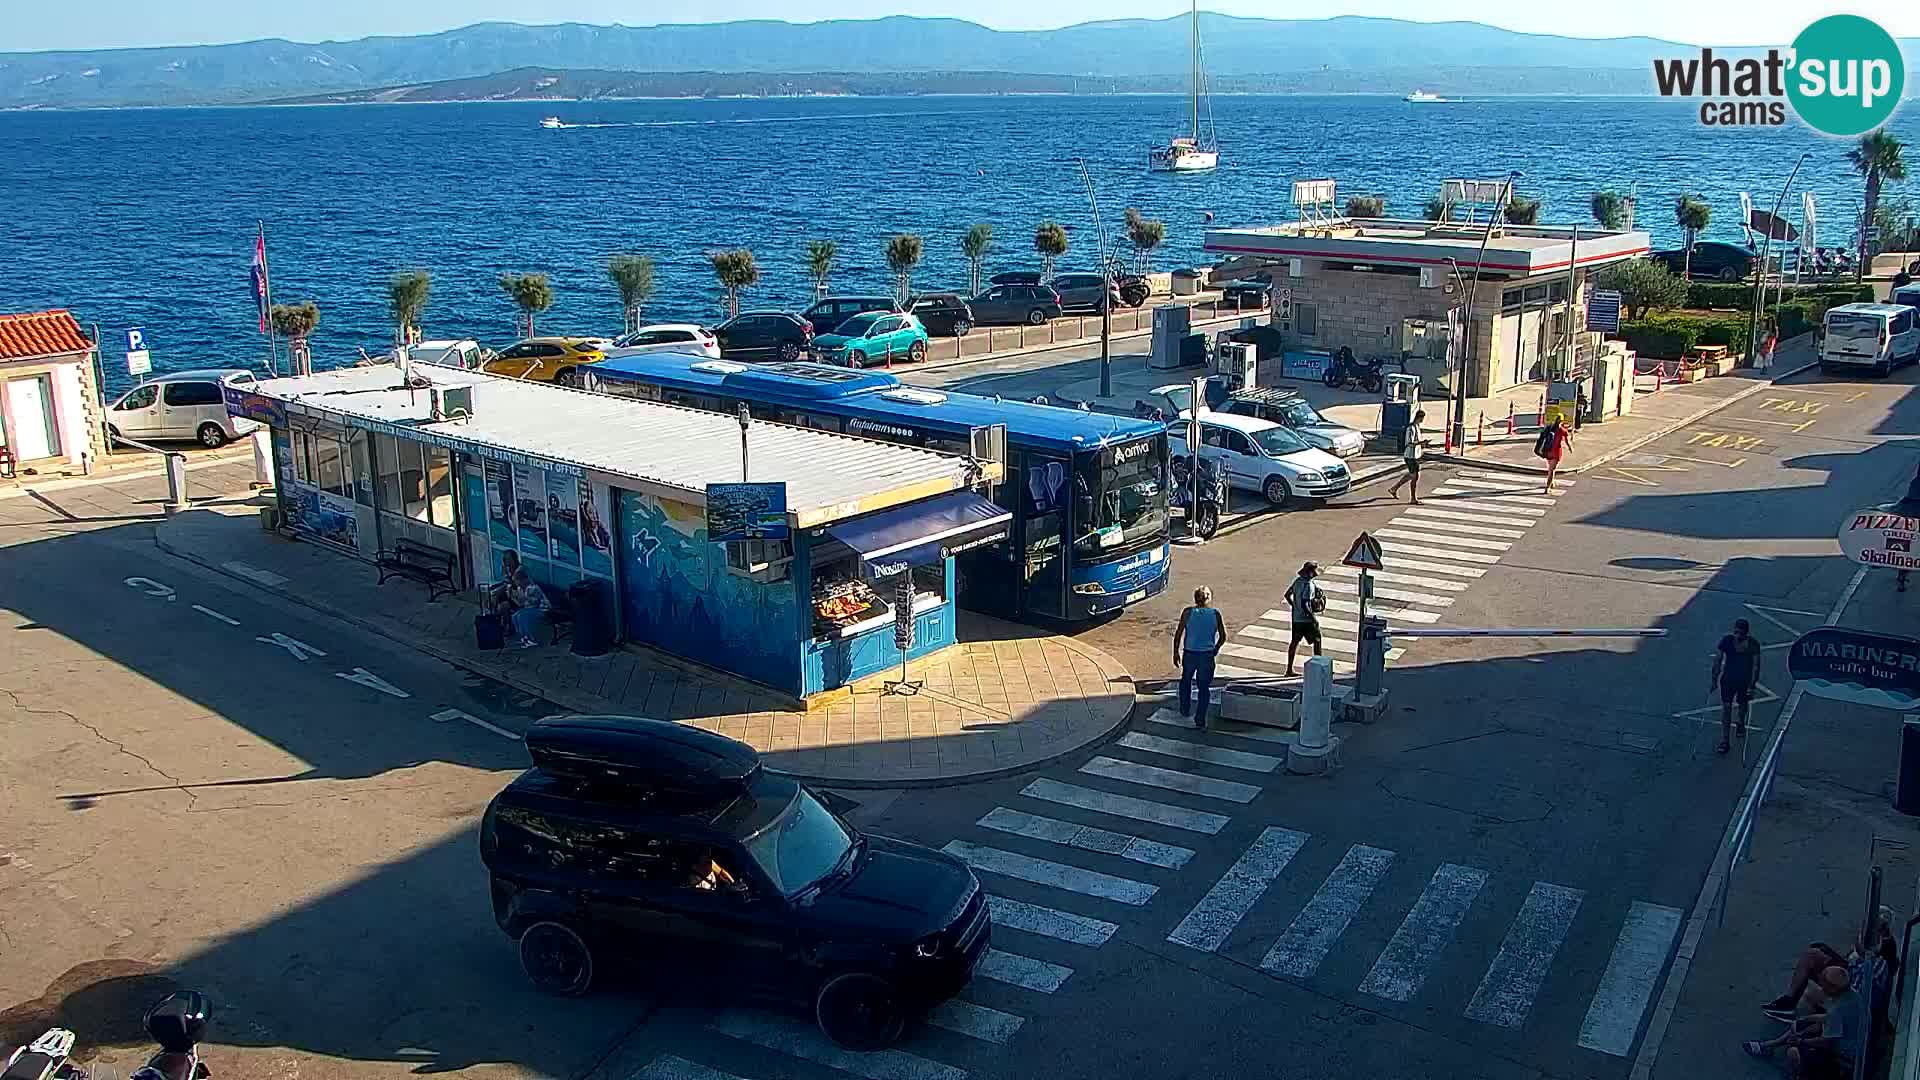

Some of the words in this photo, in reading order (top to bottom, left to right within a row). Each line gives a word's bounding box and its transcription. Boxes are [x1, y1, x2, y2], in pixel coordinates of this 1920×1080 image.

[128, 331, 142, 350] P
[1759, 398, 1830, 415] TAXI
[1124, 441, 1151, 459] arriva
[1686, 431, 1765, 451] TAXI
[495, 450, 526, 465] STATION
[529, 456, 553, 470] TICKET
[556, 462, 583, 477] OFFICE
[1830, 662, 1867, 675] caffe
[1871, 665, 1897, 680] bar
